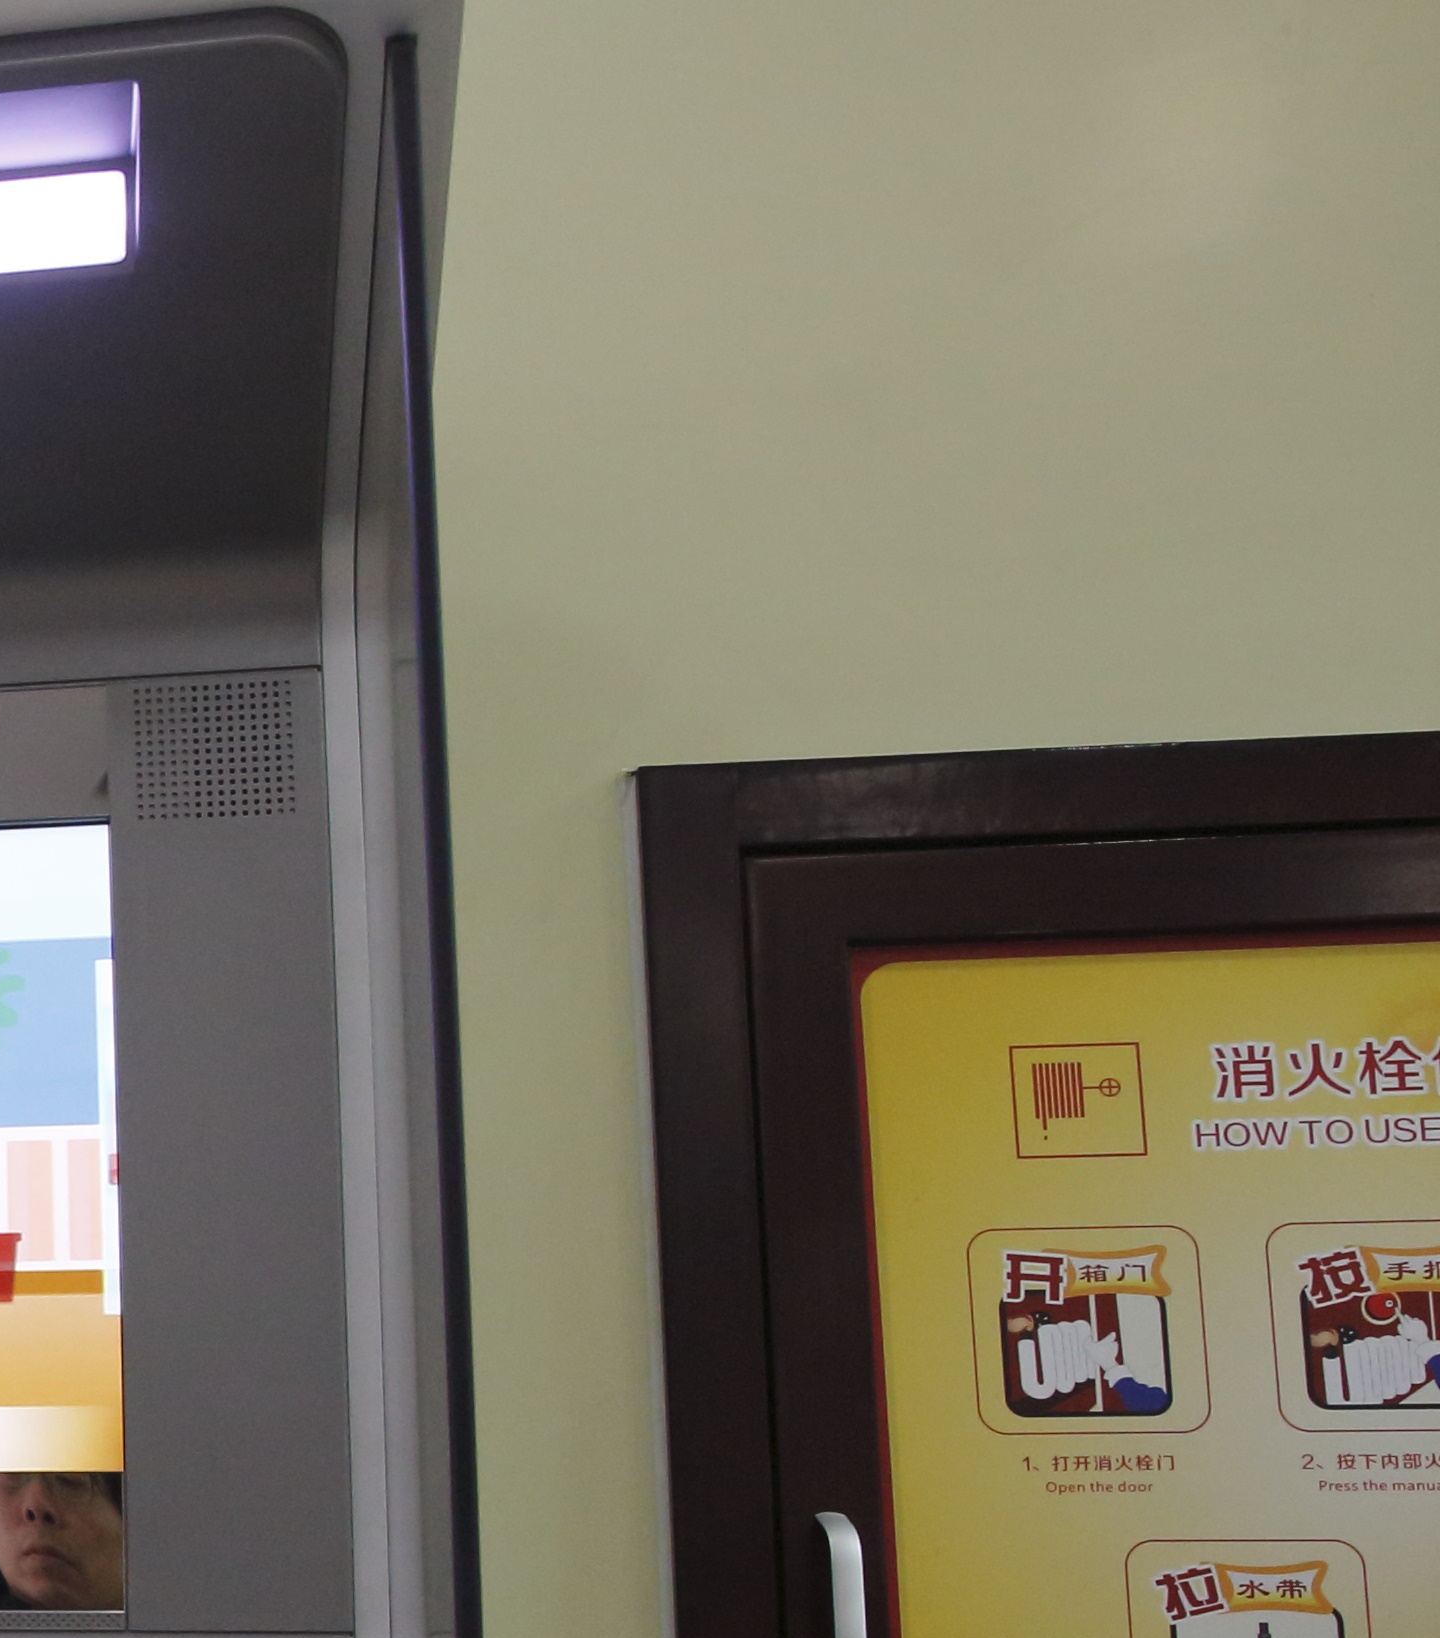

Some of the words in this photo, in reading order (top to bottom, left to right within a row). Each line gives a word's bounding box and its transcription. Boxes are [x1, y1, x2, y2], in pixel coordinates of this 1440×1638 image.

[1215, 1040, 1440, 1099] 消火栓
[1195, 1121, 1288, 1148] HOW
[1299, 1119, 1354, 1145] TO
[1364, 1116, 1440, 1144] USE
[1045, 1481, 1086, 1495] Open
[1090, 1481, 1113, 1493] the
[1118, 1481, 1153, 1493] door
[1318, 1480, 1359, 1492] Press
[1363, 1480, 1388, 1492] the
